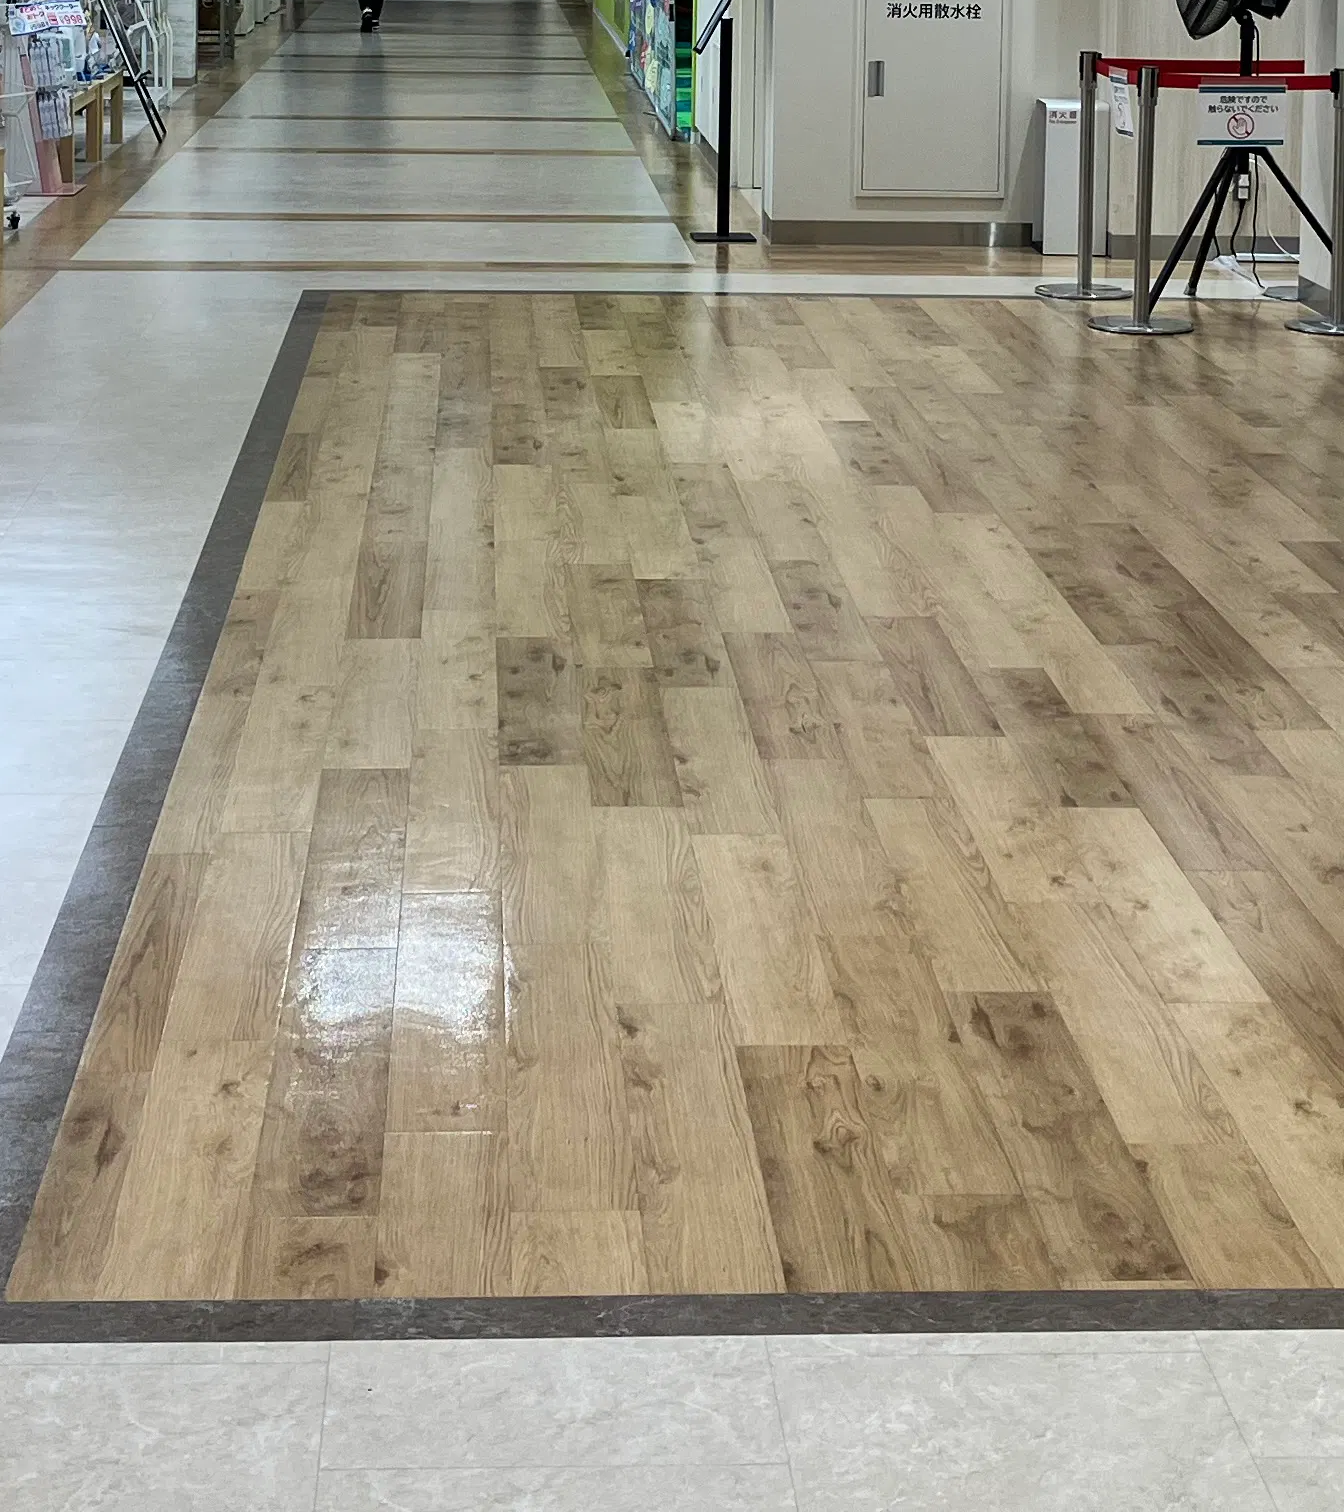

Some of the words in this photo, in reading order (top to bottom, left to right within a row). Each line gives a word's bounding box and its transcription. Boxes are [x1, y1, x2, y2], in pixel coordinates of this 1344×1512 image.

[886, 2, 982, 20] 消火用散水栓
[1219, 95, 1268, 104] 危険ですので
[1207, 104, 1279, 113] 触らないでください
